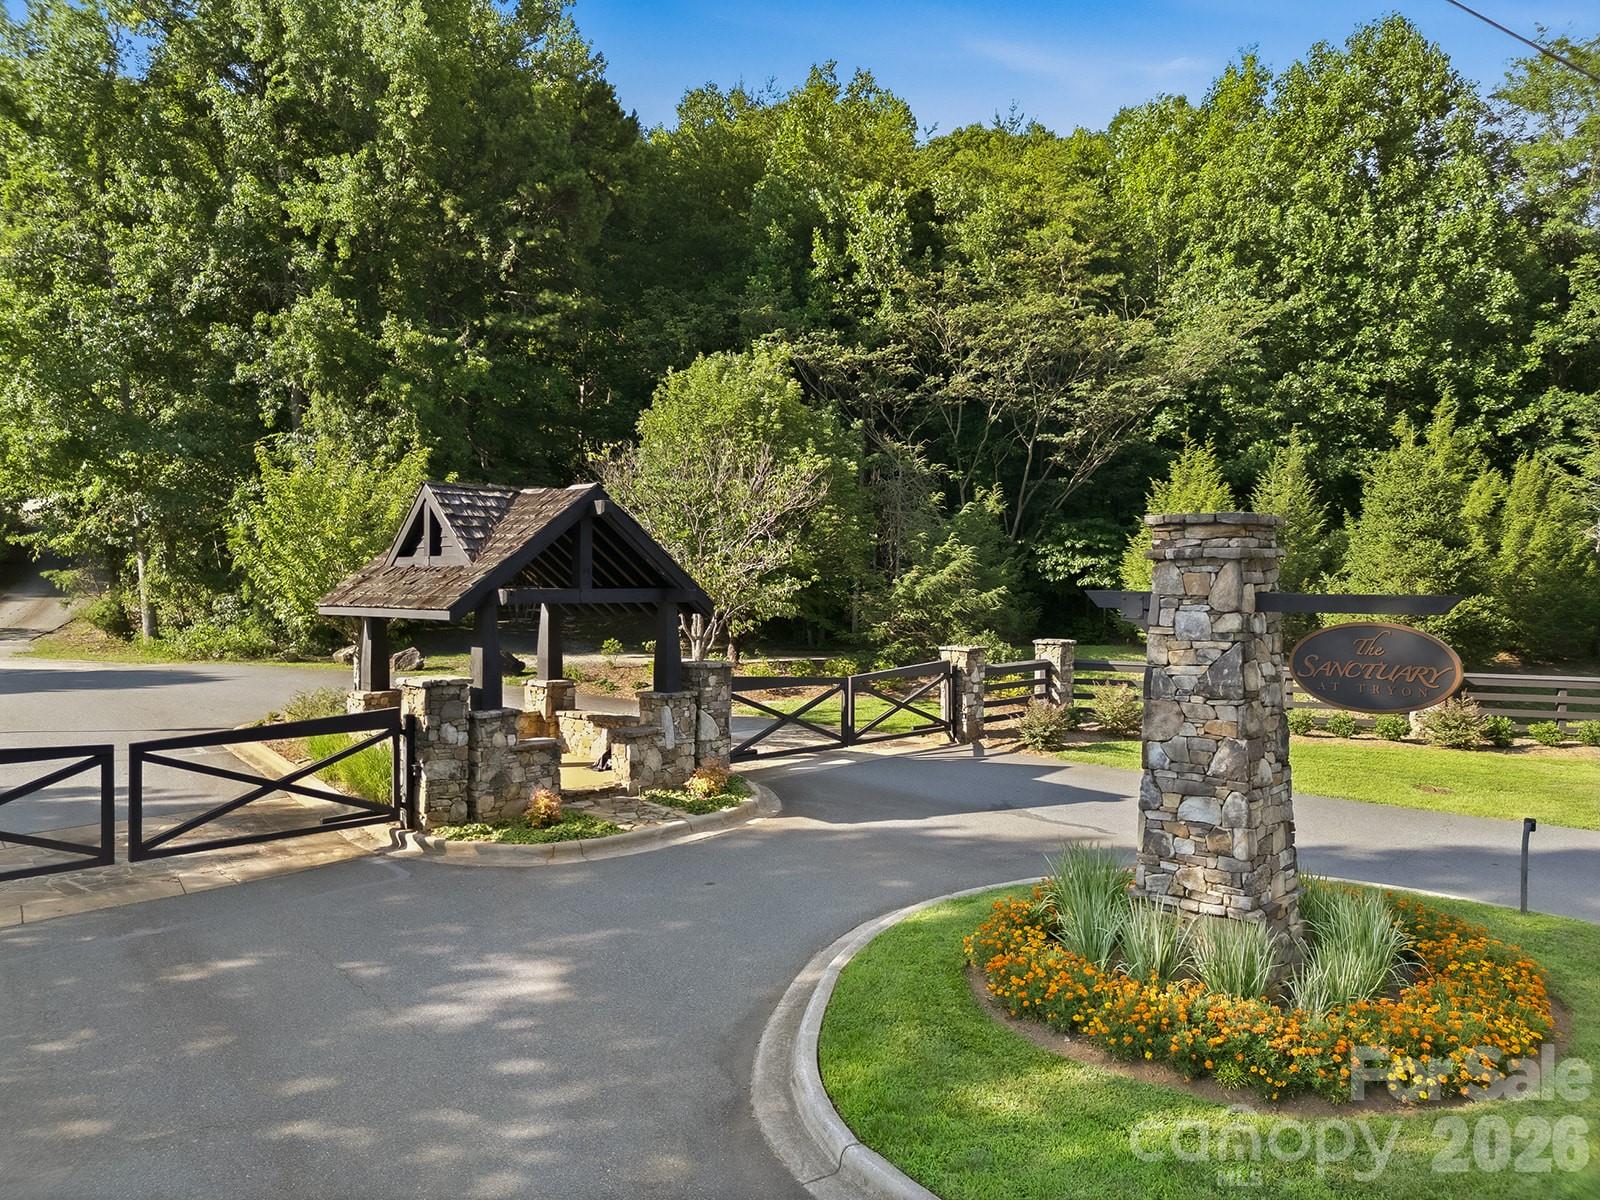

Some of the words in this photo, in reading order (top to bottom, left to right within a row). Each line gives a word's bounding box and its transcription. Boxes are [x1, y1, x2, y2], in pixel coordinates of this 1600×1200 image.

[1353, 630, 1392, 656] The
[1297, 654, 1453, 688] SANCTUARY
[1318, 681, 1340, 691] AT
[1359, 684, 1429, 697] TRYON
